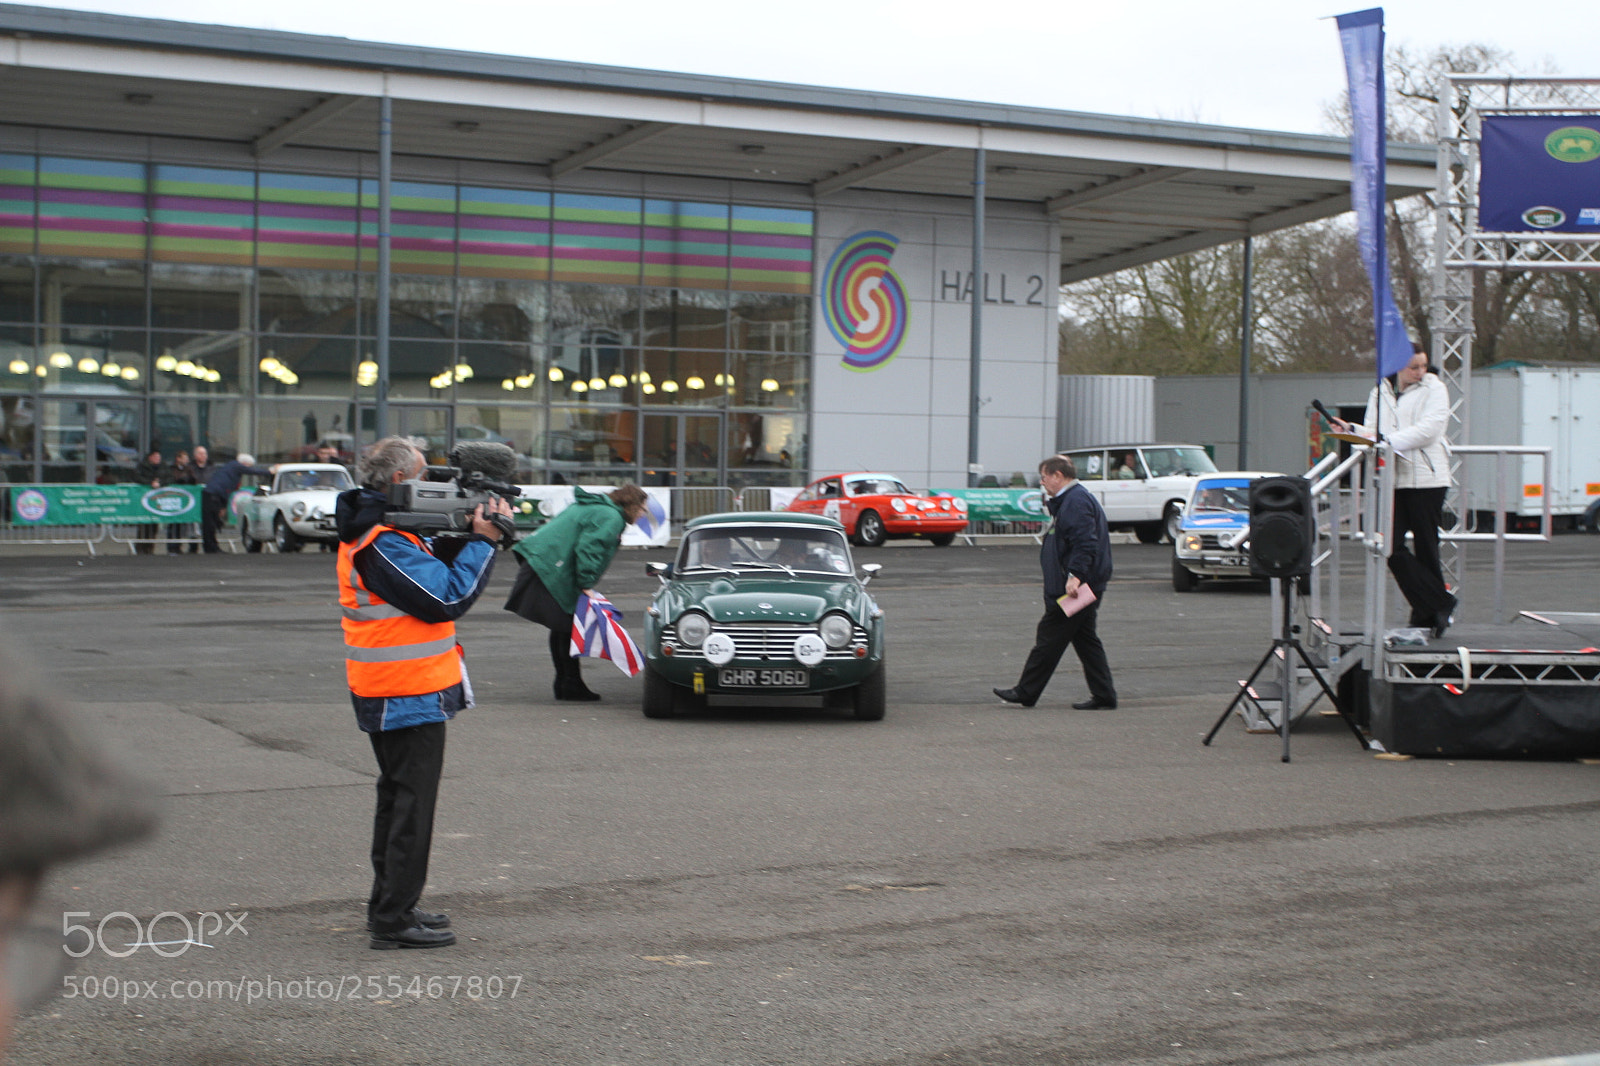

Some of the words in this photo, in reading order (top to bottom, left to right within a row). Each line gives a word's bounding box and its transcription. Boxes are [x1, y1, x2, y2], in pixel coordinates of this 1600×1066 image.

[941, 270, 1015, 304] HALL
[1027, 275, 1043, 305] 2
[722, 670, 757, 685] GHR
